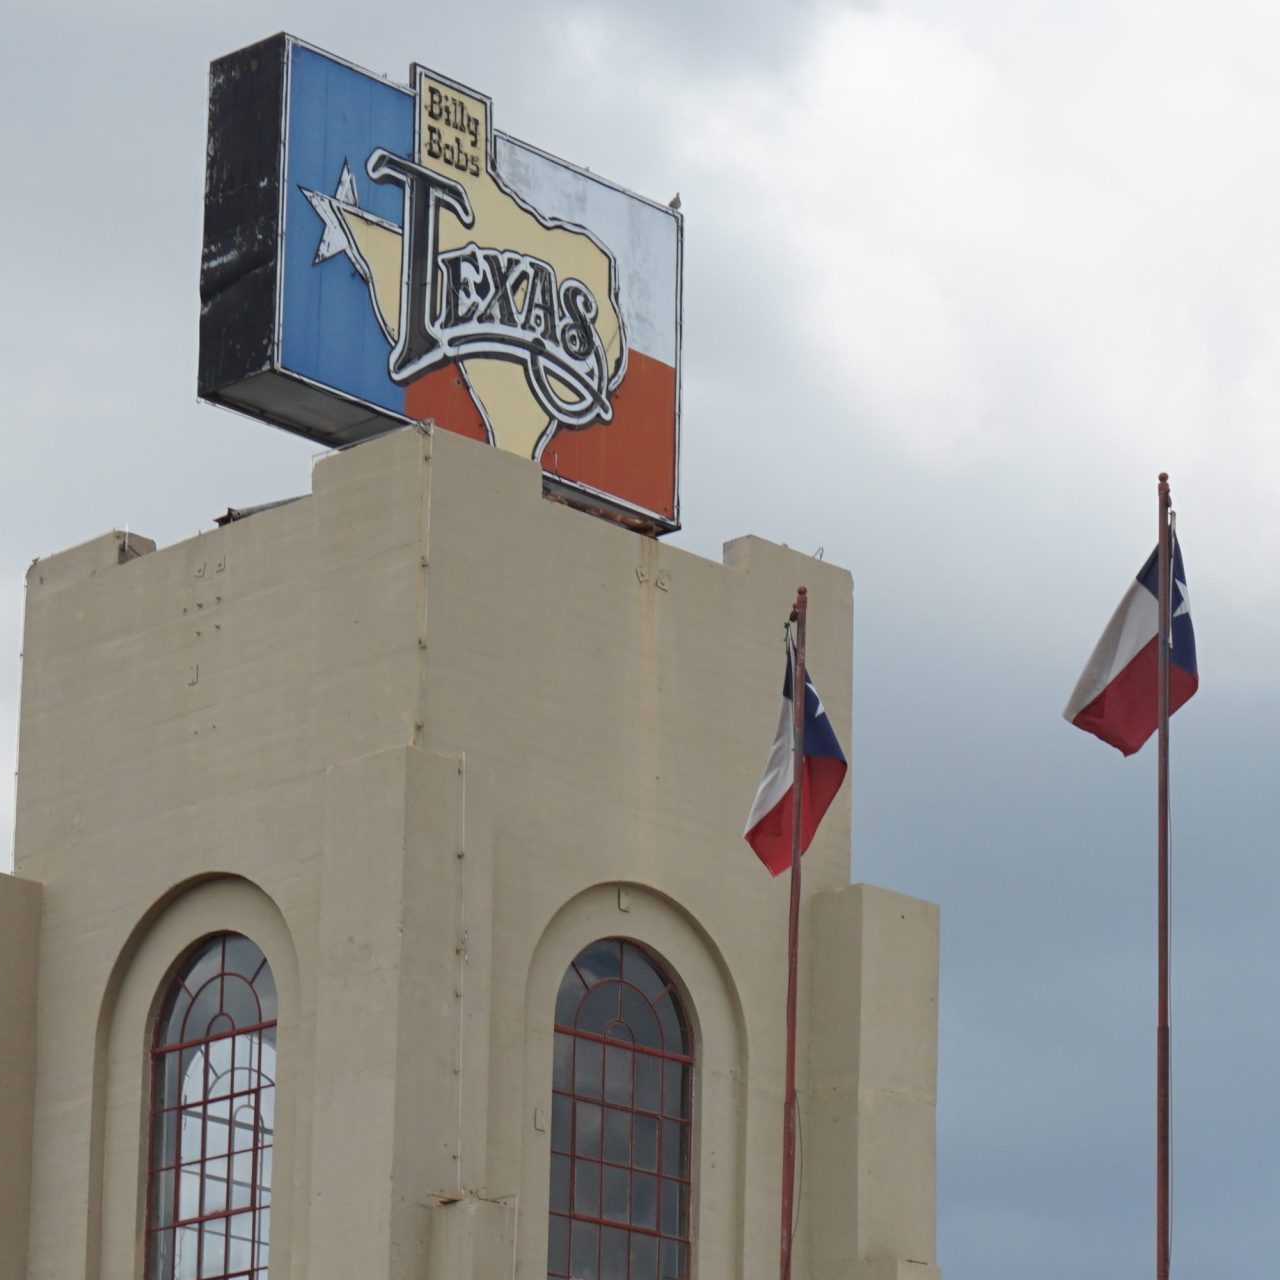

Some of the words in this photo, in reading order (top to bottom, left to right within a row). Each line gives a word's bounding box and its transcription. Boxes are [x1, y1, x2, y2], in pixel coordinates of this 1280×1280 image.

[428, 86, 480, 147] Billy
[427, 124, 480, 178] Bobs
[366, 148, 601, 385] TEXAS
